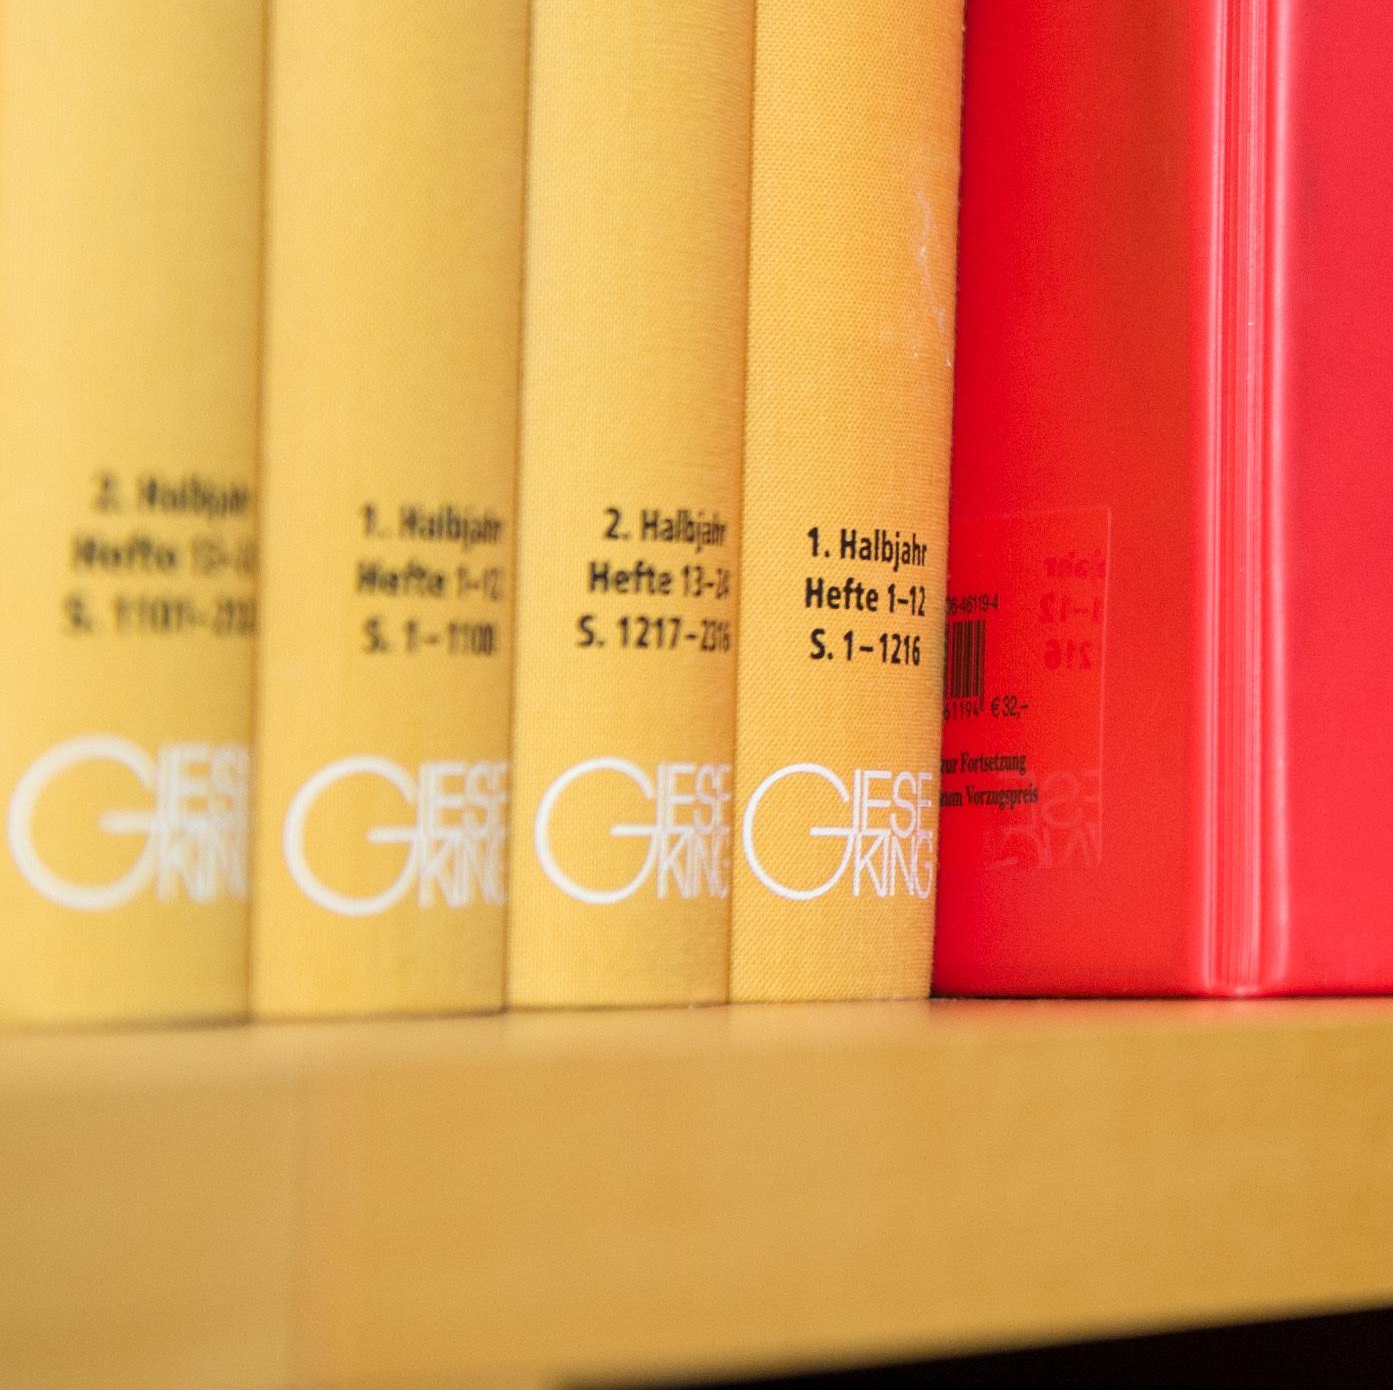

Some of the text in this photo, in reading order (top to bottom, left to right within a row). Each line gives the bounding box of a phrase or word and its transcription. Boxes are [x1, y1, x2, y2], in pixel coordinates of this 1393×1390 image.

[605, 507, 727, 555] 2. Halbjahr
[807, 526, 928, 573] 1. Halbjahr
[589, 560, 673, 596] Hefte
[805, 577, 880, 613] Hefte
[578, 613, 604, 648] S.
[810, 627, 834, 660] S.
[961, 751, 1027, 776] Fortsetzung
[966, 783, 1039, 810] Vorzugspreis
